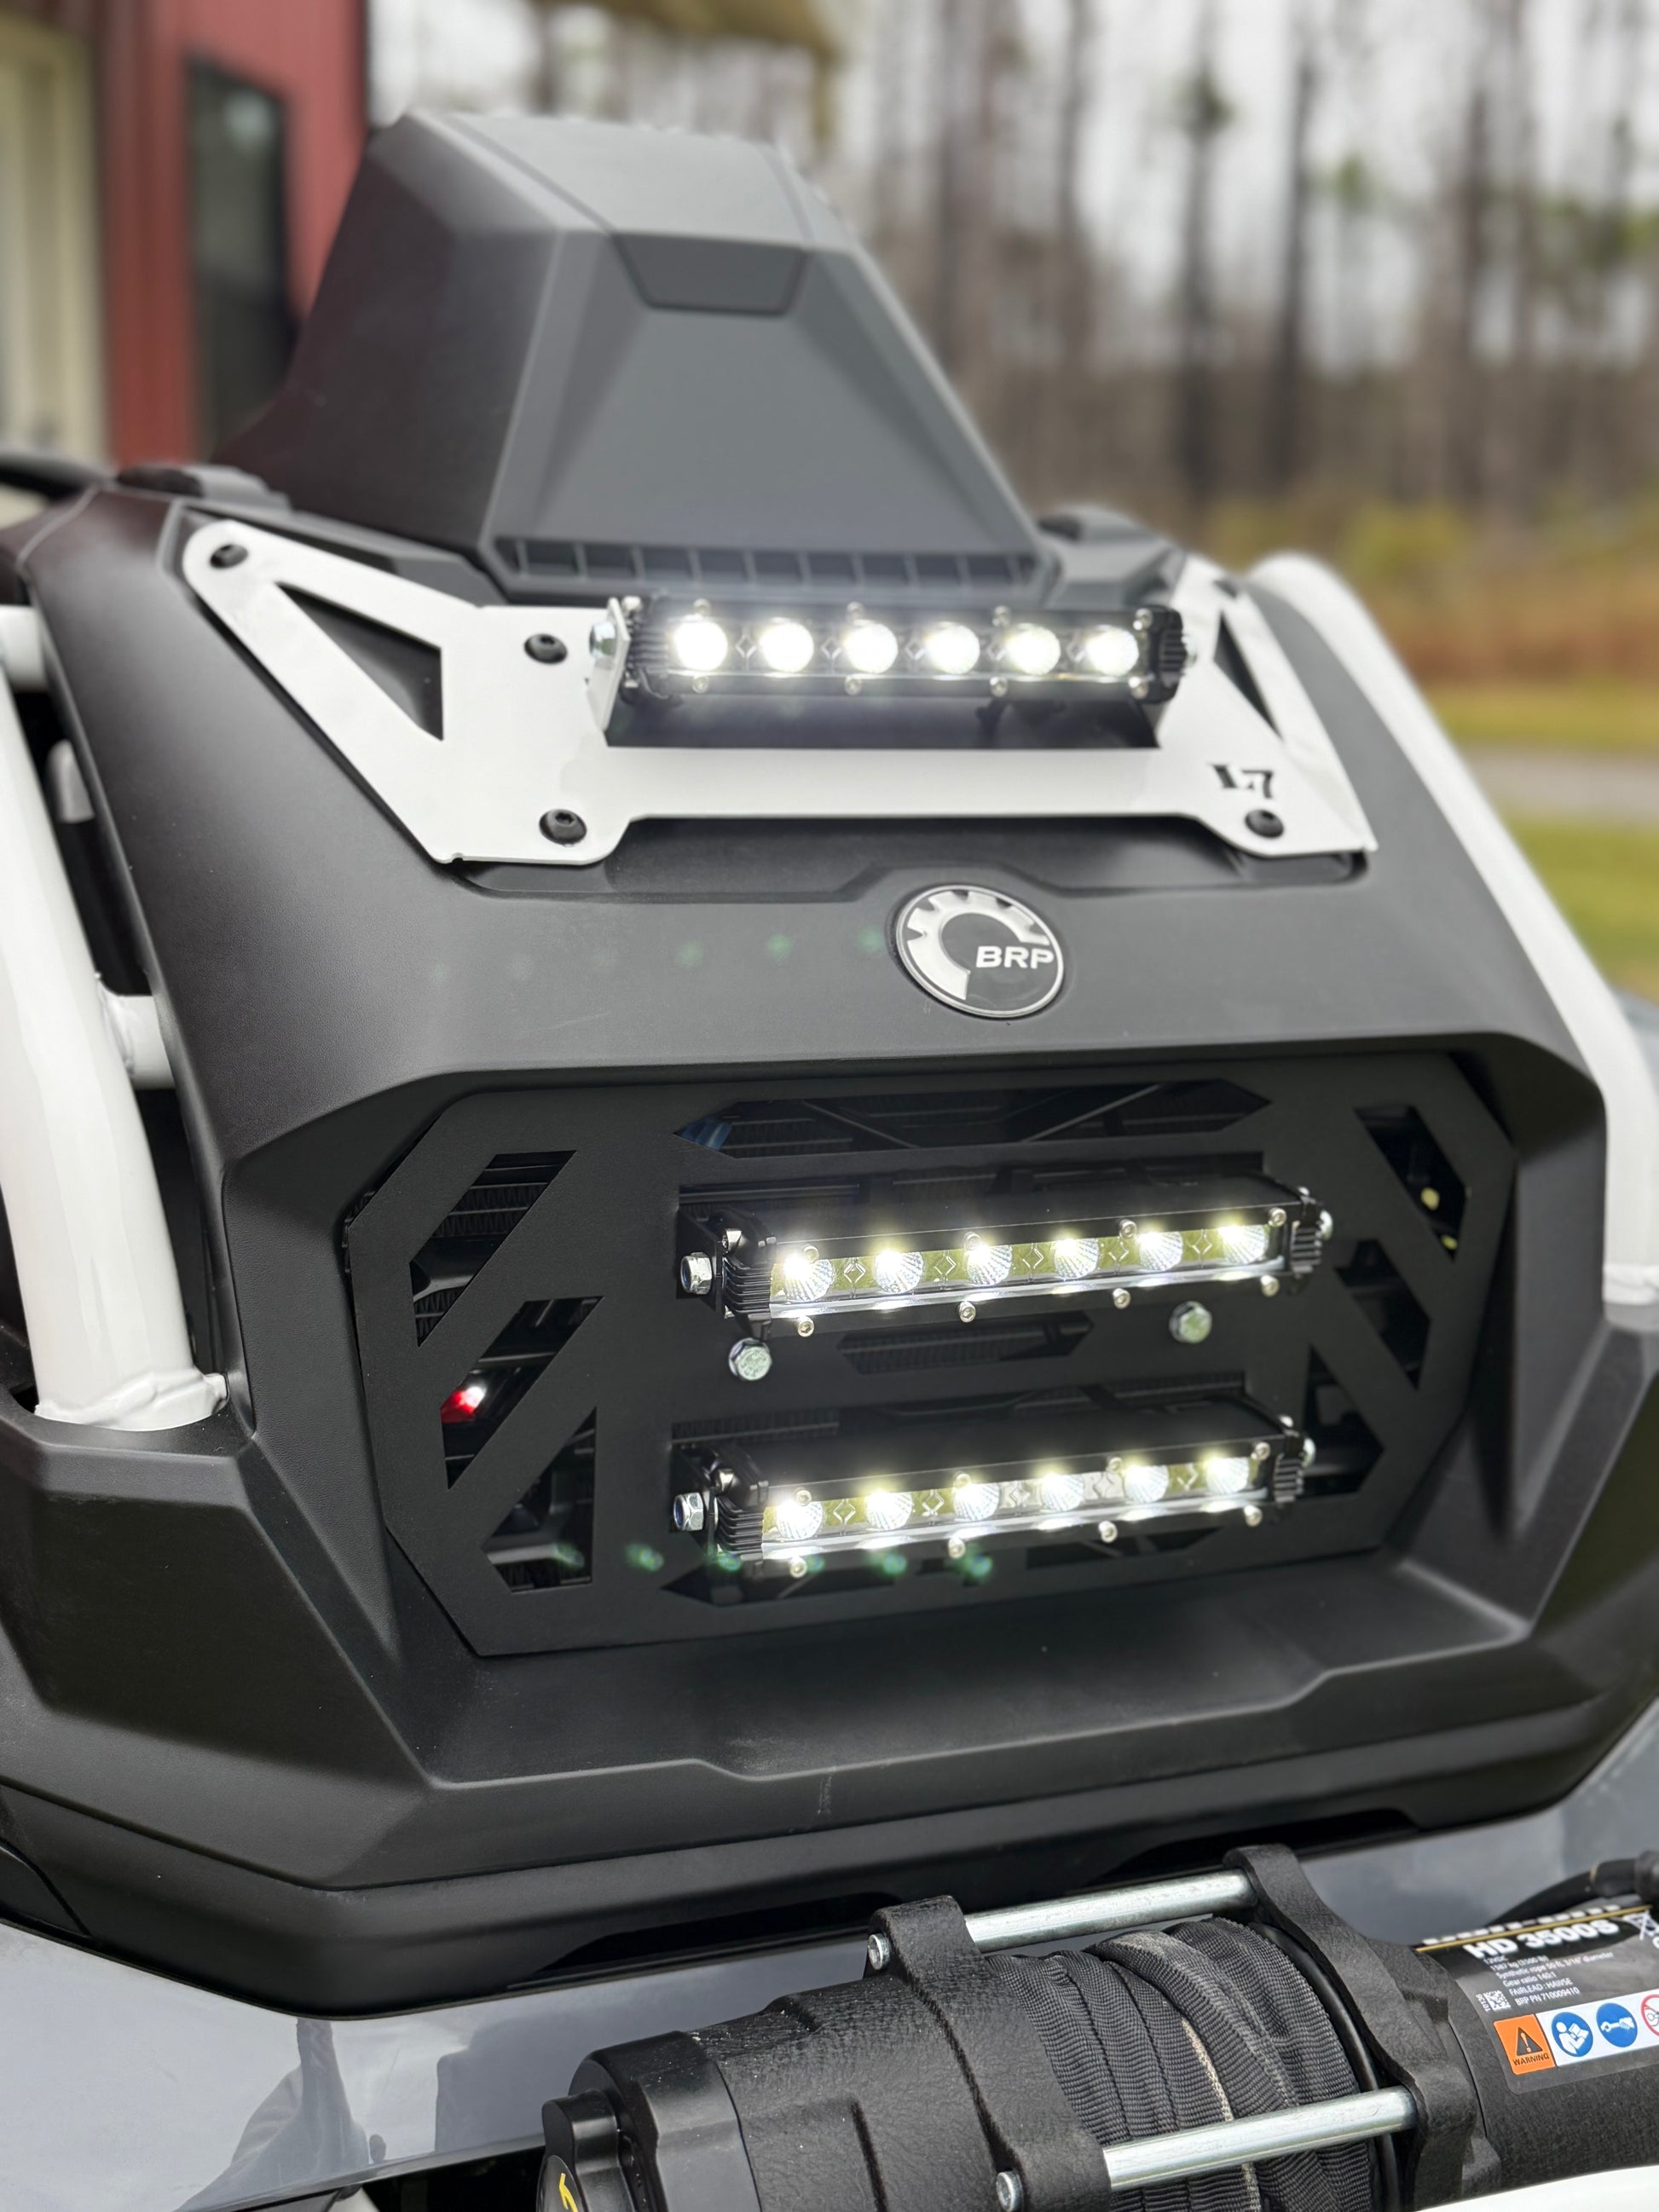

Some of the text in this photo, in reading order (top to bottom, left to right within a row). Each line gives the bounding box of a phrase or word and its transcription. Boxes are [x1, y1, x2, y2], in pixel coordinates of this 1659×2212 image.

[974, 945, 1055, 969] BRP
[1463, 1918, 1620, 1960] HD 3500S
[1495, 1968, 1529, 1979] Synthetic
[1529, 1964, 1546, 1972] rope
[1582, 1951, 1614, 1962] diameter
[1502, 1978, 1520, 1987] Gear
[1520, 1975, 1538, 1984] ratio
[1508, 1983, 1544, 1996] FAIRLEAD
[1545, 1977, 1574, 1990] HAWSE
[1514, 1995, 1529, 2007] BRP
[1529, 1993, 1542, 2003] PN
[1512, 2052, 1550, 2067] WARNING
